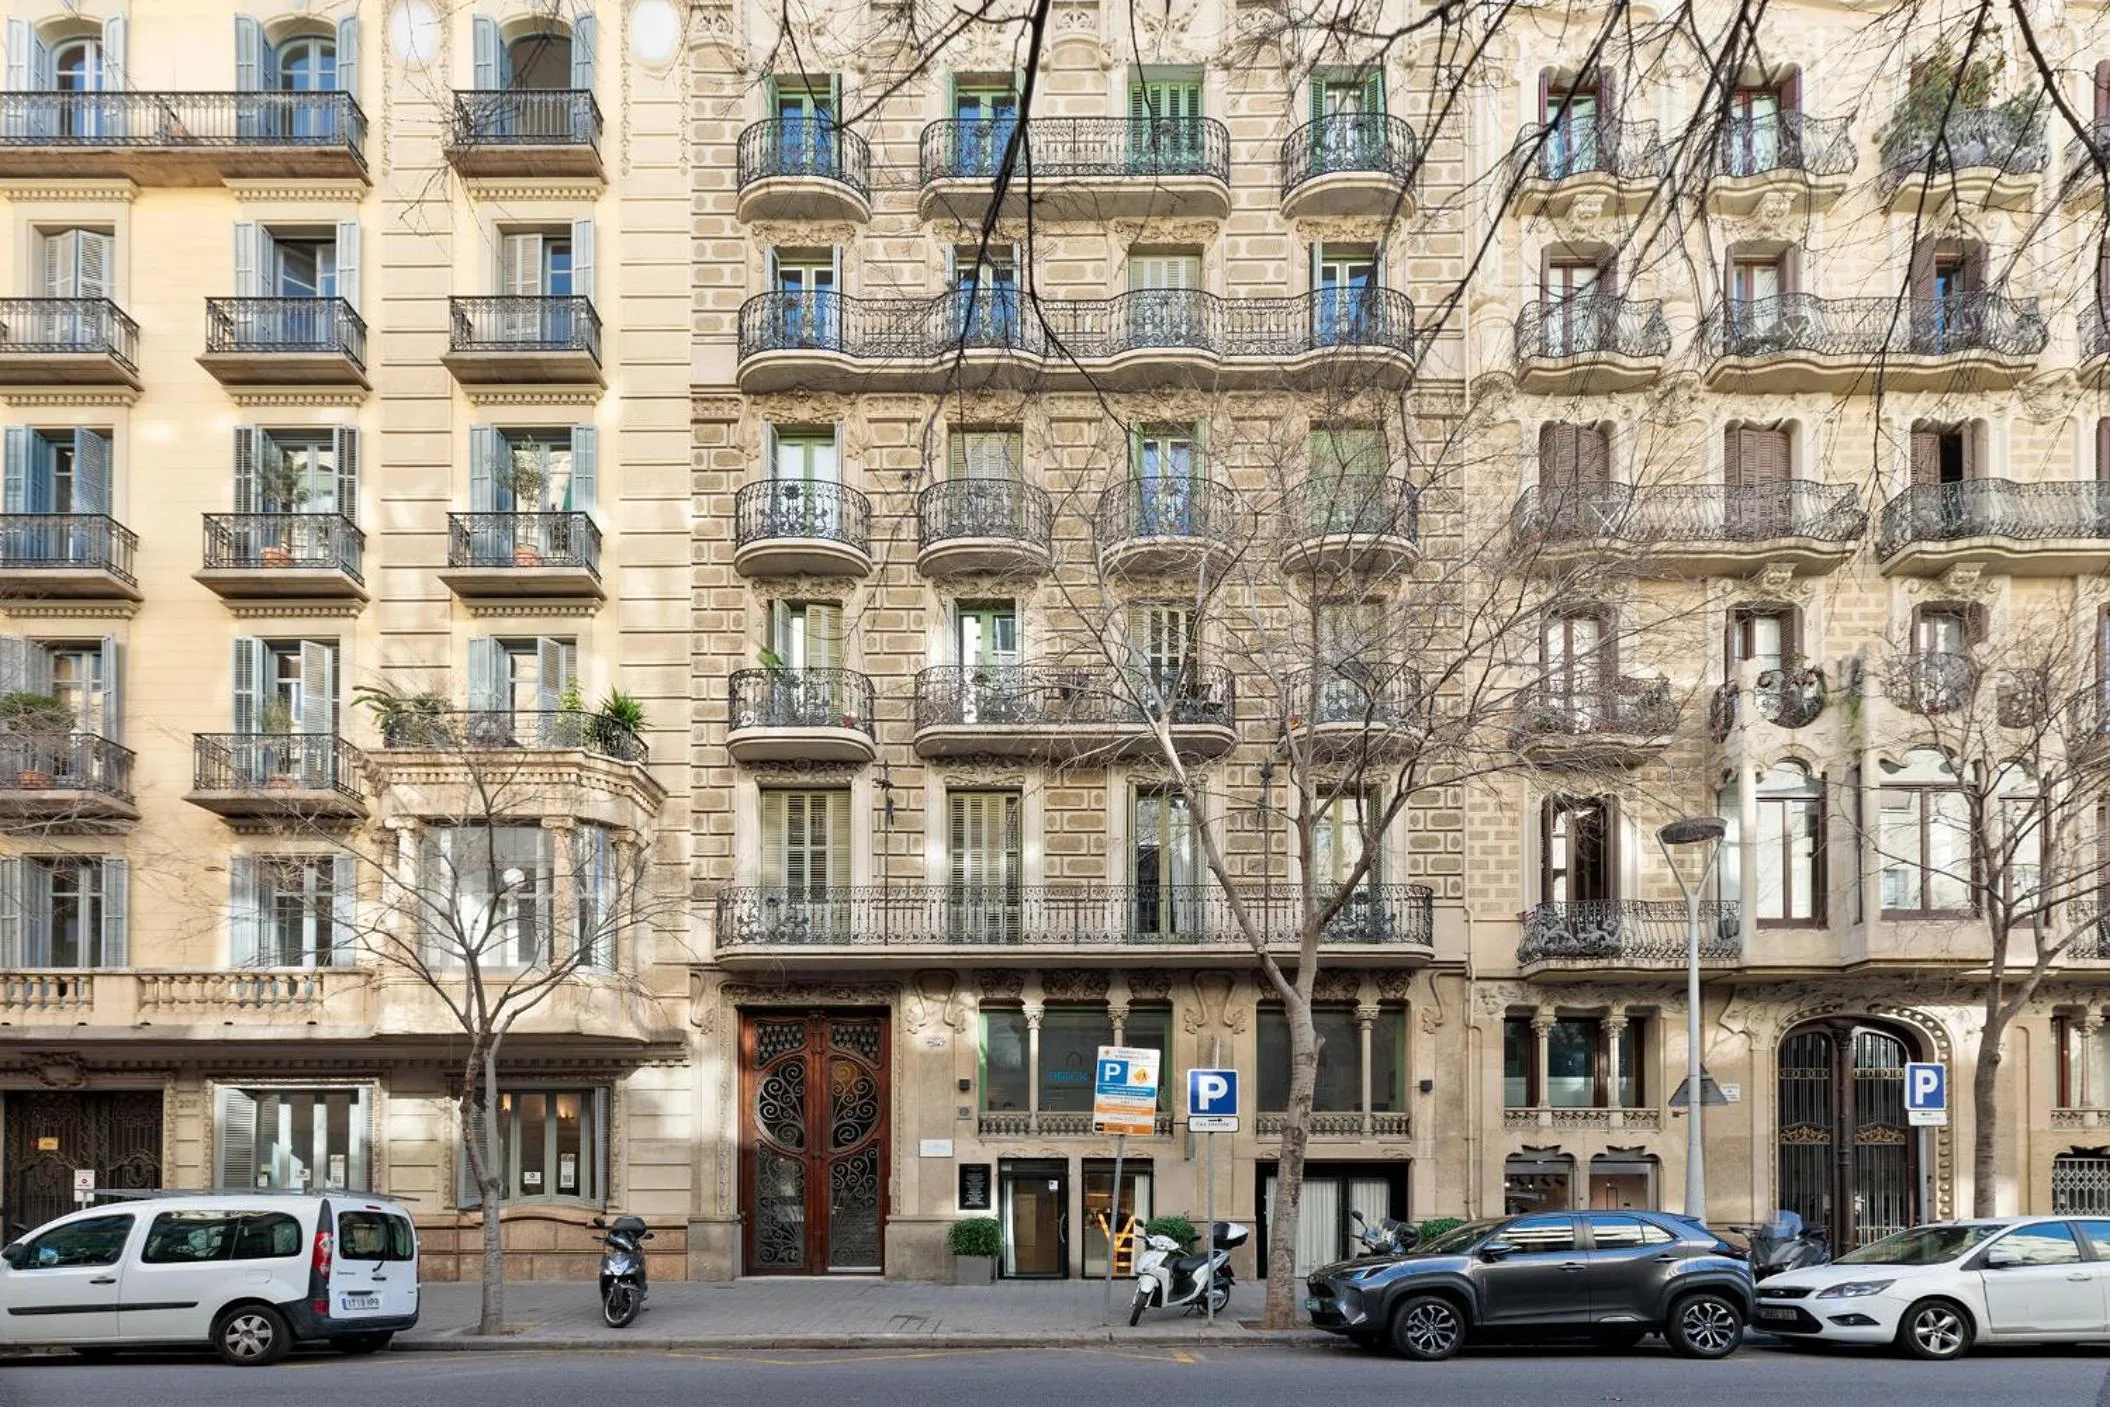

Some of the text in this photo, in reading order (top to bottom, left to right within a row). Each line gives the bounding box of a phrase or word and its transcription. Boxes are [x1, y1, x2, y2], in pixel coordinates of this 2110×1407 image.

[1104, 1063, 1121, 1082] P
[1915, 1069, 1938, 1105] P
[1199, 1075, 1228, 1110] P
